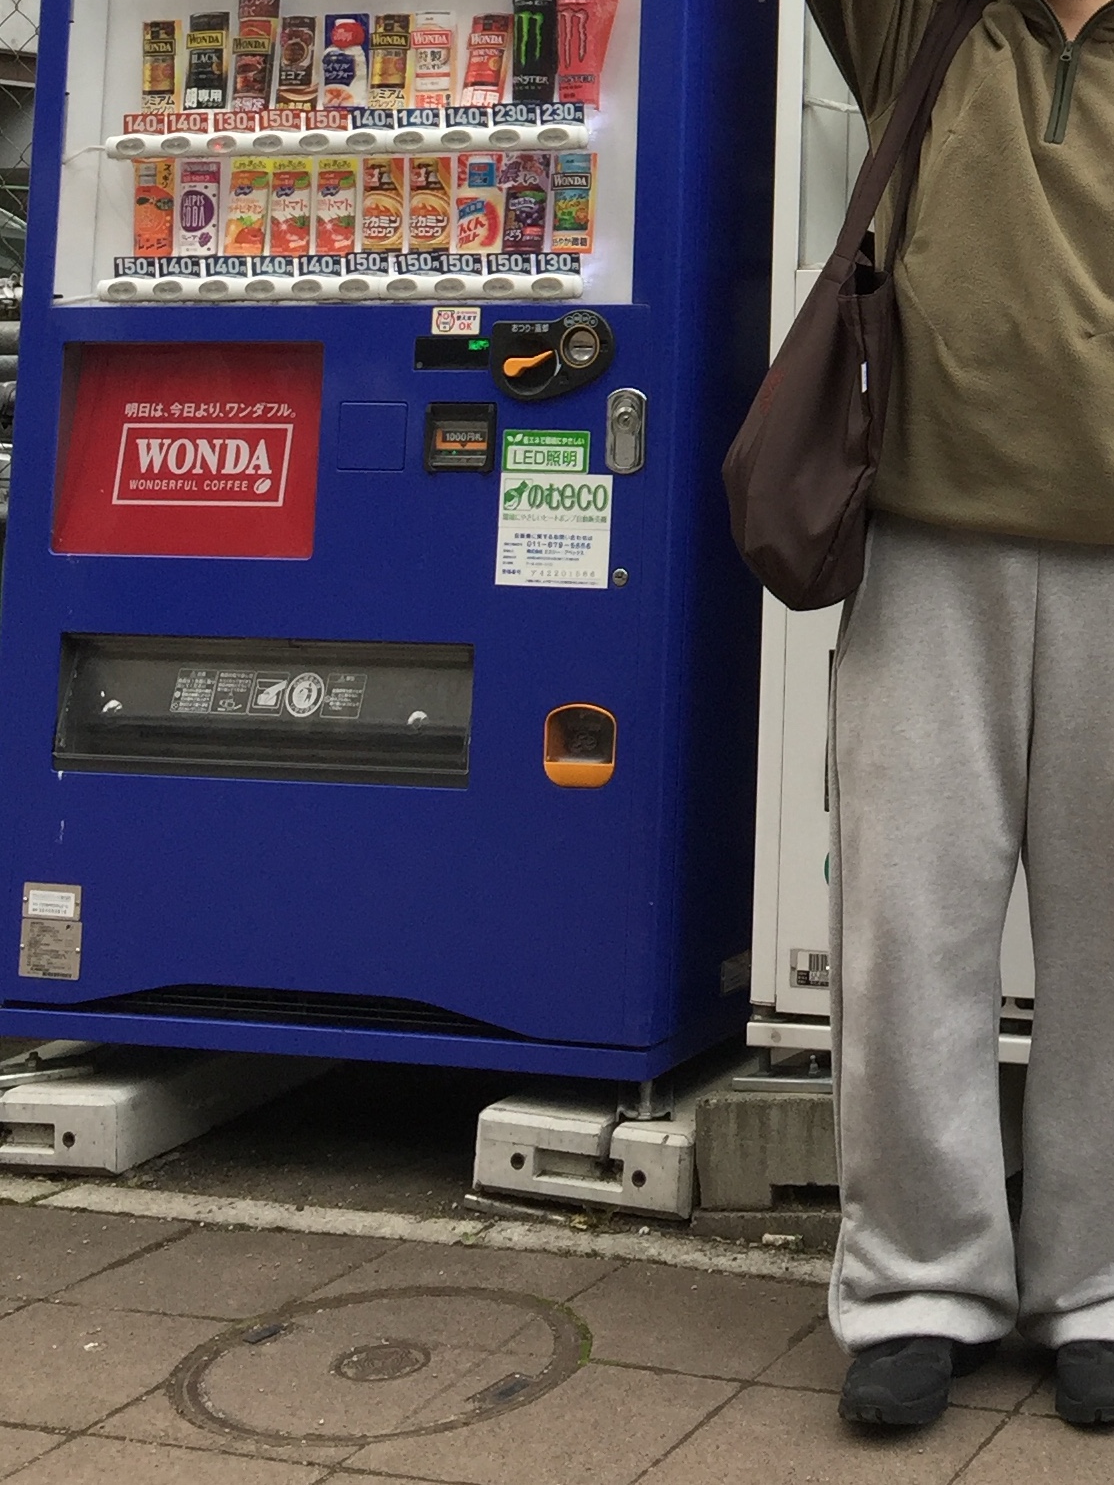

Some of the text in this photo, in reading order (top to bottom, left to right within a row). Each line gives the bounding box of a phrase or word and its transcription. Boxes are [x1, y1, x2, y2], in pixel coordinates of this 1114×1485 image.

[188, 33, 221, 45] WONDA
[235, 39, 267, 50] WONDA
[371, 35, 407, 46] WONDA
[412, 33, 449, 44] WONDA
[471, 33, 503, 45] WONDA
[260, 111, 300, 127] 150円
[308, 111, 348, 127] 150円
[353, 109, 394, 125] 140円
[398, 109, 440, 125] 140円
[447, 108, 488, 124] 140円
[494, 104, 535, 122] 230円
[542, 103, 583, 120] 230円
[126, 115, 163, 132] 140円
[169, 115, 207, 131] 140円
[216, 113, 254, 130] 130円
[554, 174, 587, 187] WONDA
[282, 198, 308, 212] トマト
[327, 198, 353, 212] トマト
[116, 257, 155, 274] 150円
[160, 257, 200, 274] 140円
[207, 257, 247, 274] 140円
[253, 257, 293, 273] 140円
[301, 256, 341, 273] 140円
[348, 253, 388, 270] 150円
[399, 253, 440, 272] 150円
[440, 255, 482, 272] 150円
[489, 254, 531, 271] 150円
[539, 253, 579, 270] 130円
[458, 322, 474, 331] OK
[124, 402, 297, 419] 明日は、今日より、ワンダフル。
[135, 438, 272, 475] WONDA
[512, 449, 578, 468] LED照明
[128, 479, 249, 492] WONDERFUL COFFEE
